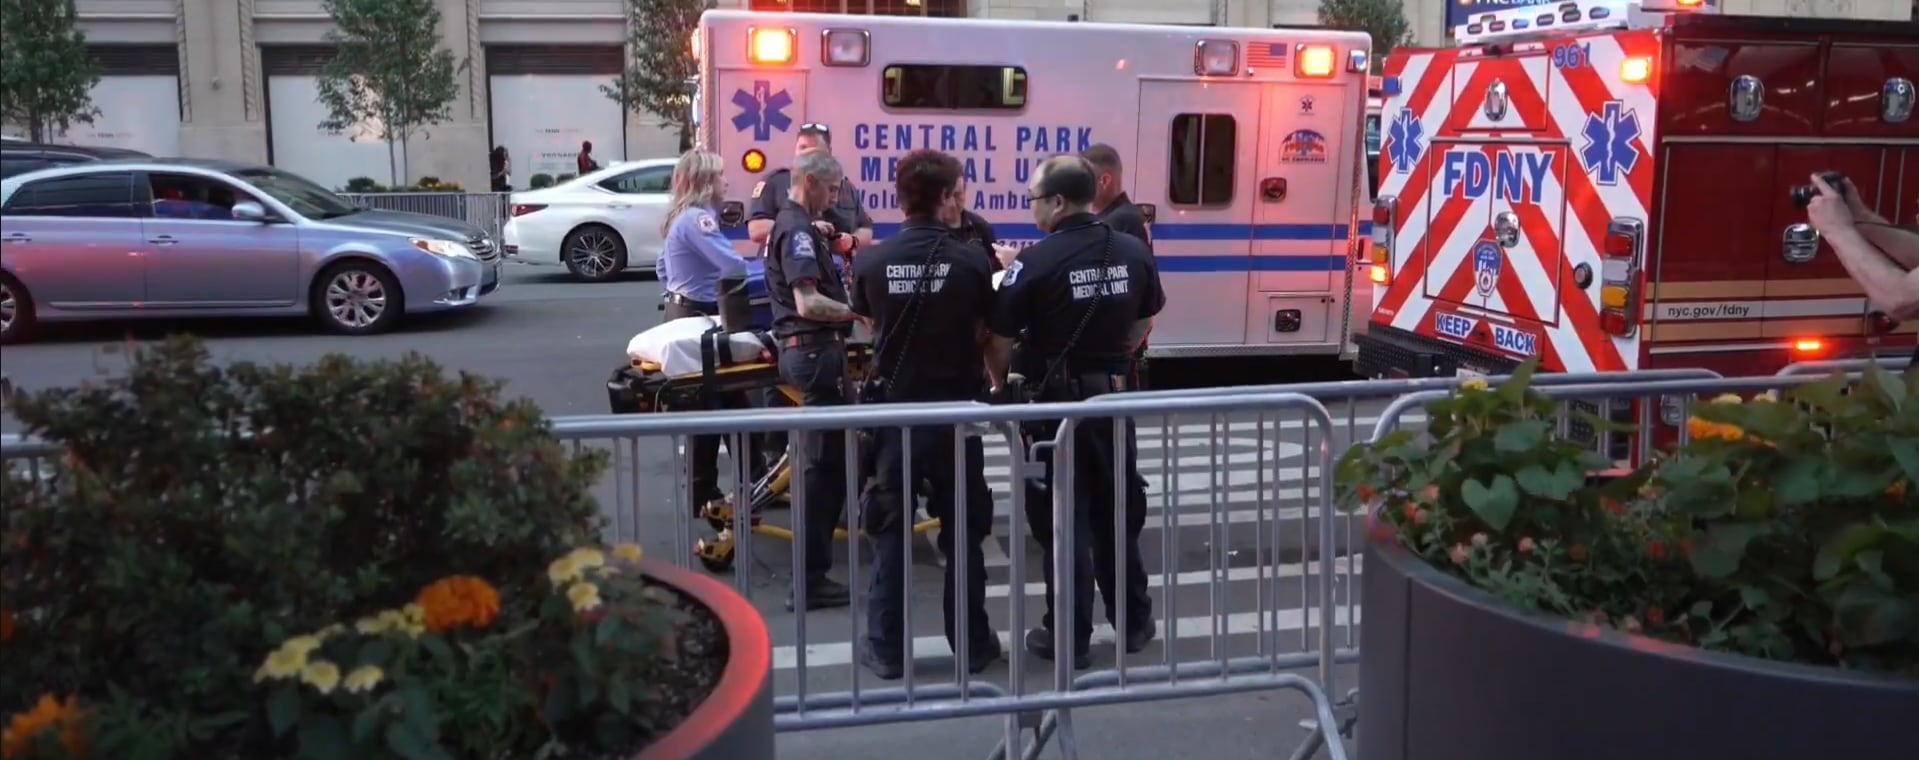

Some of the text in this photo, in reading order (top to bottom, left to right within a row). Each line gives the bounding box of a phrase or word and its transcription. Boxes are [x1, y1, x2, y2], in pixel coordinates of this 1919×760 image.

[1554, 42, 1591, 69] 961
[854, 123, 1092, 152] CENTRAL PARK
[1443, 150, 1554, 203] FDNY
[1107, 265, 1129, 280] PARK
[1110, 280, 1129, 295] UNIT
[1668, 304, 1750, 318] nyc.gov/fdny
[1436, 312, 1536, 354] KEEP BACK
